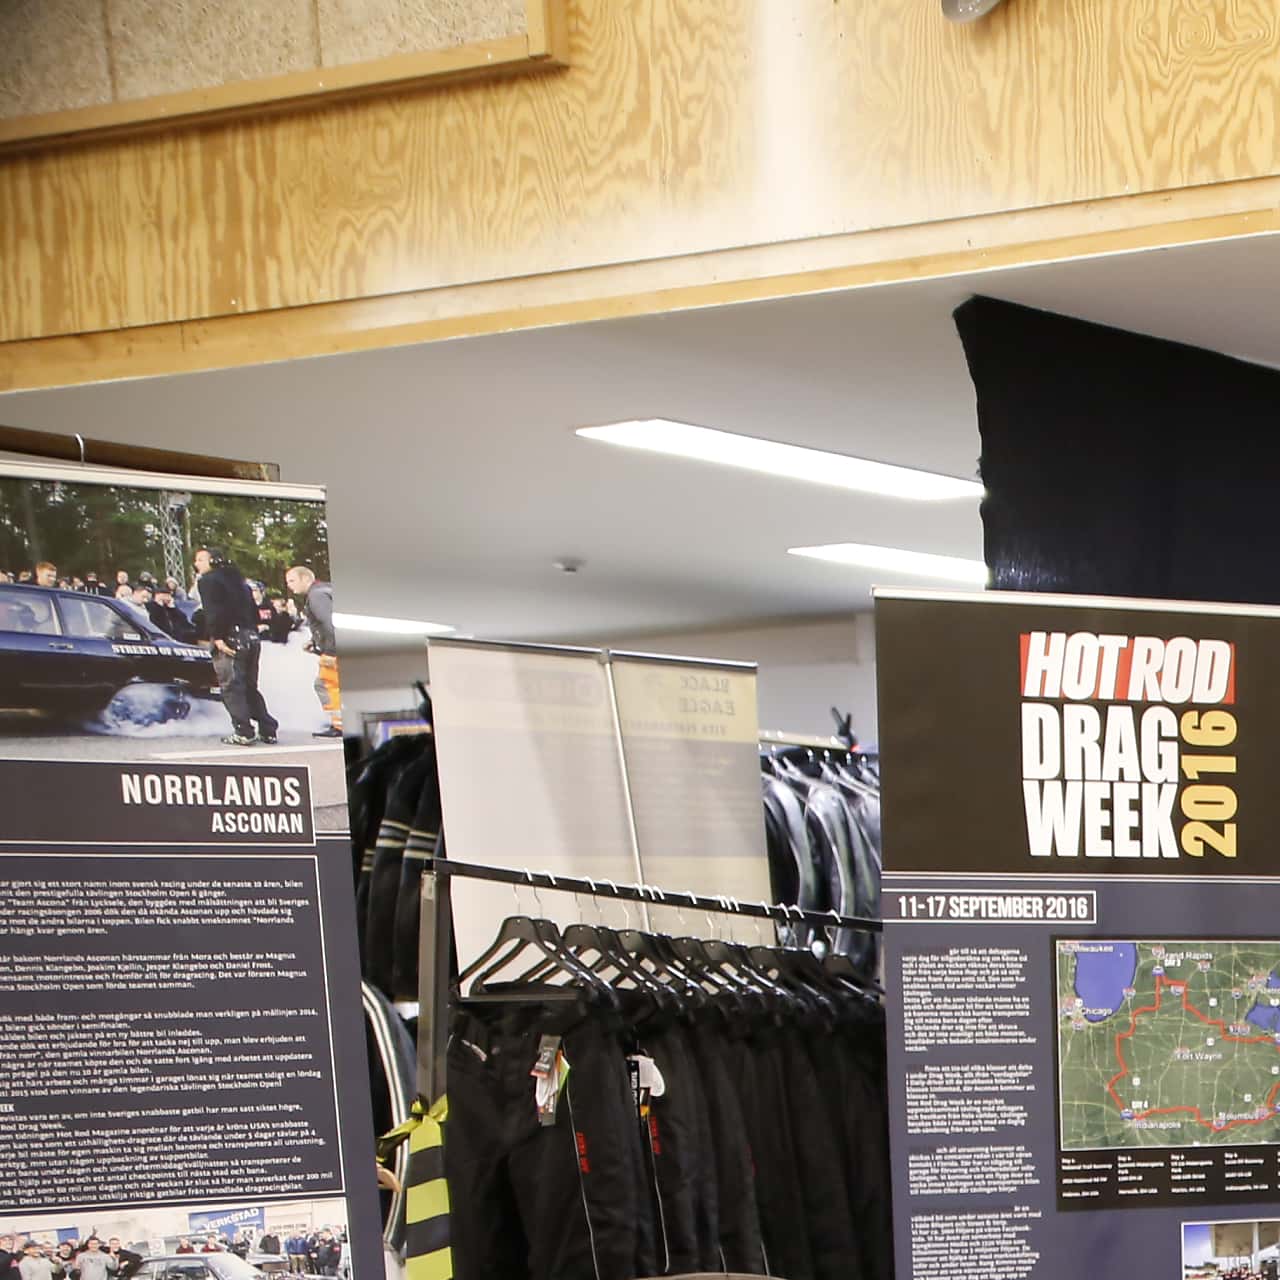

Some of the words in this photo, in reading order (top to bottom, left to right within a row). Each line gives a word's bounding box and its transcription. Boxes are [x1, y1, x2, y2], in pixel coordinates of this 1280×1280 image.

[1023, 631, 1128, 701] HOT
[1127, 636, 1232, 704] ROD
[1021, 701, 1179, 784] DRAG
[121, 774, 301, 806] NORRLANDS
[1022, 778, 1180, 859] WEEK
[1180, 709, 1238, 858] 2016
[212, 812, 303, 834] ASCONAN
[898, 895, 947, 919] 11-17
[948, 895, 1044, 919] SEPTEMBER
[1045, 897, 1088, 919] 2016
